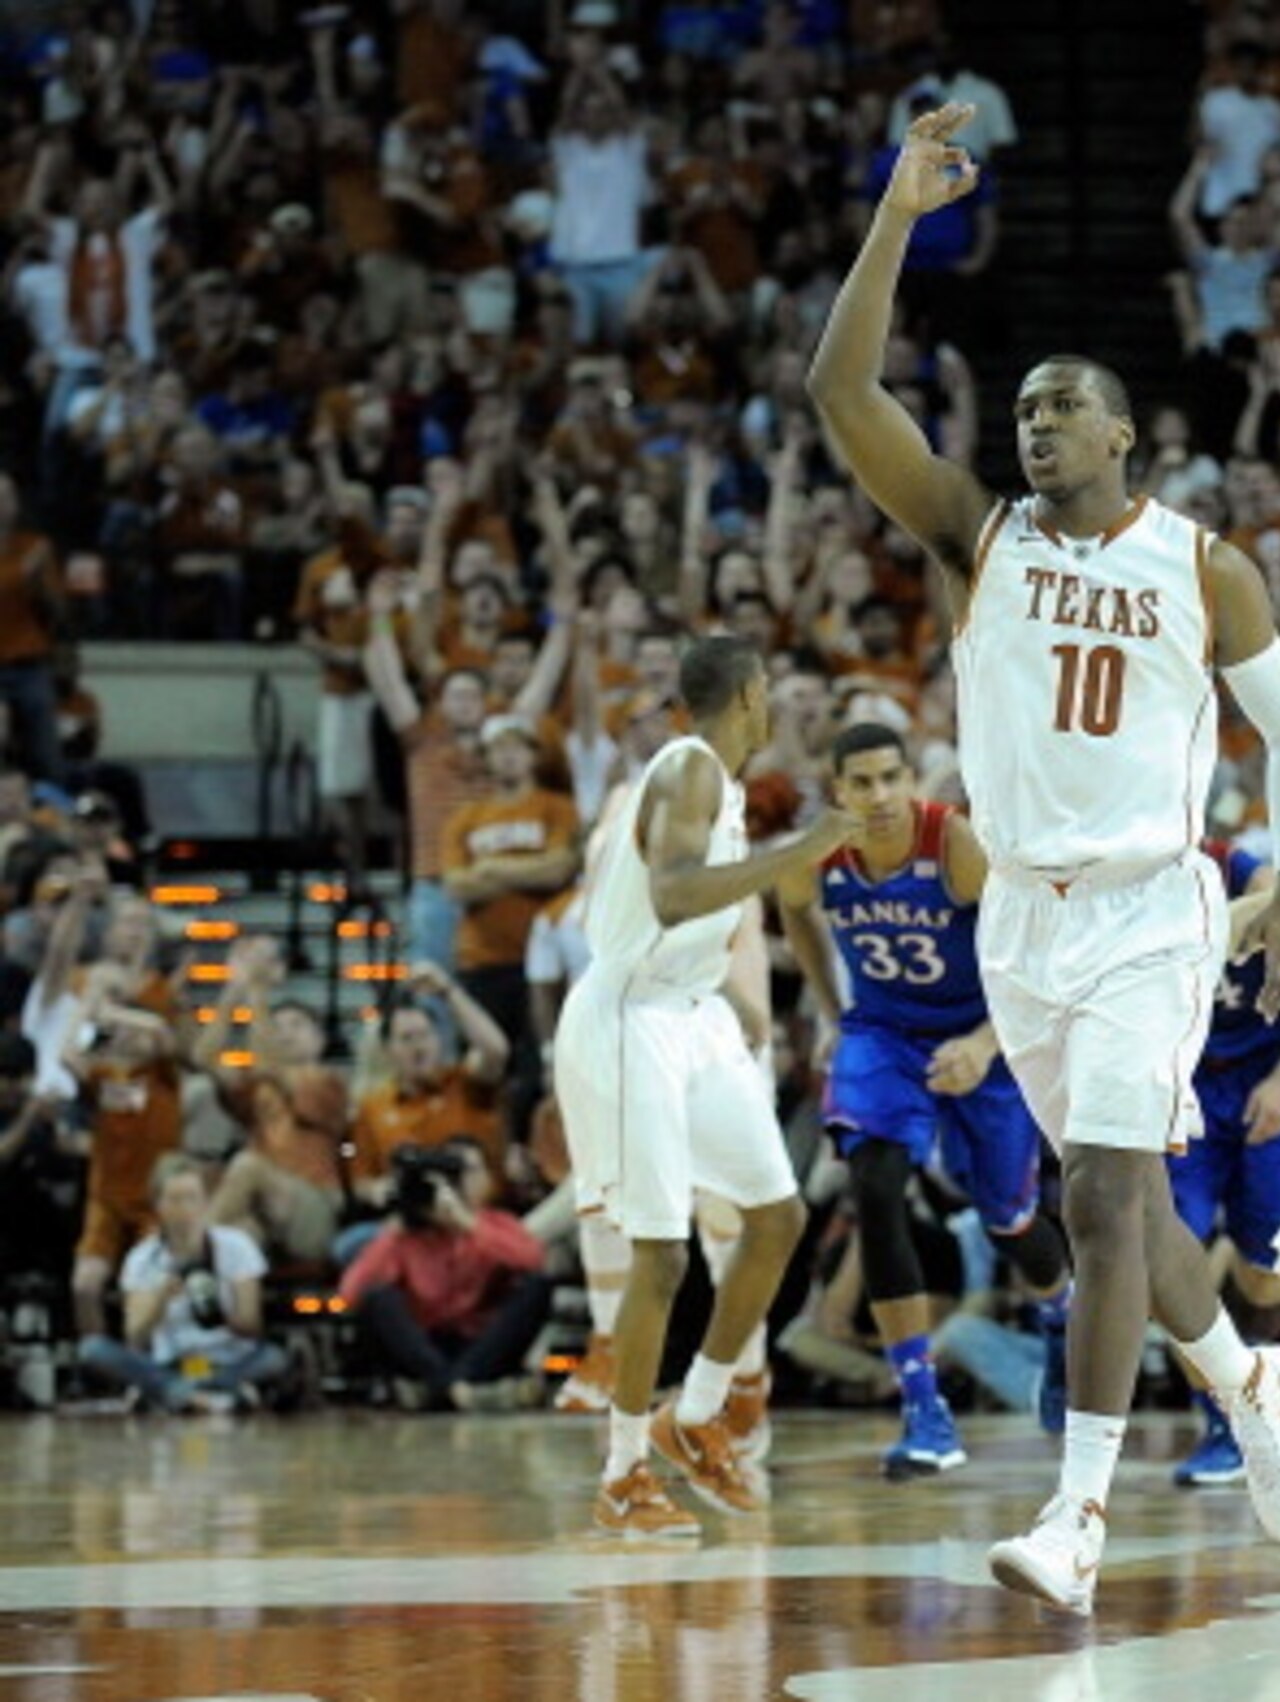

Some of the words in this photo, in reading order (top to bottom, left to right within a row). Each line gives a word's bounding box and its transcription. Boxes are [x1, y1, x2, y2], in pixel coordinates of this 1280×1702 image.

[1025, 567, 1160, 638] TEXAS
[1052, 644, 1126, 736] 10
[852, 933, 946, 985] 33
